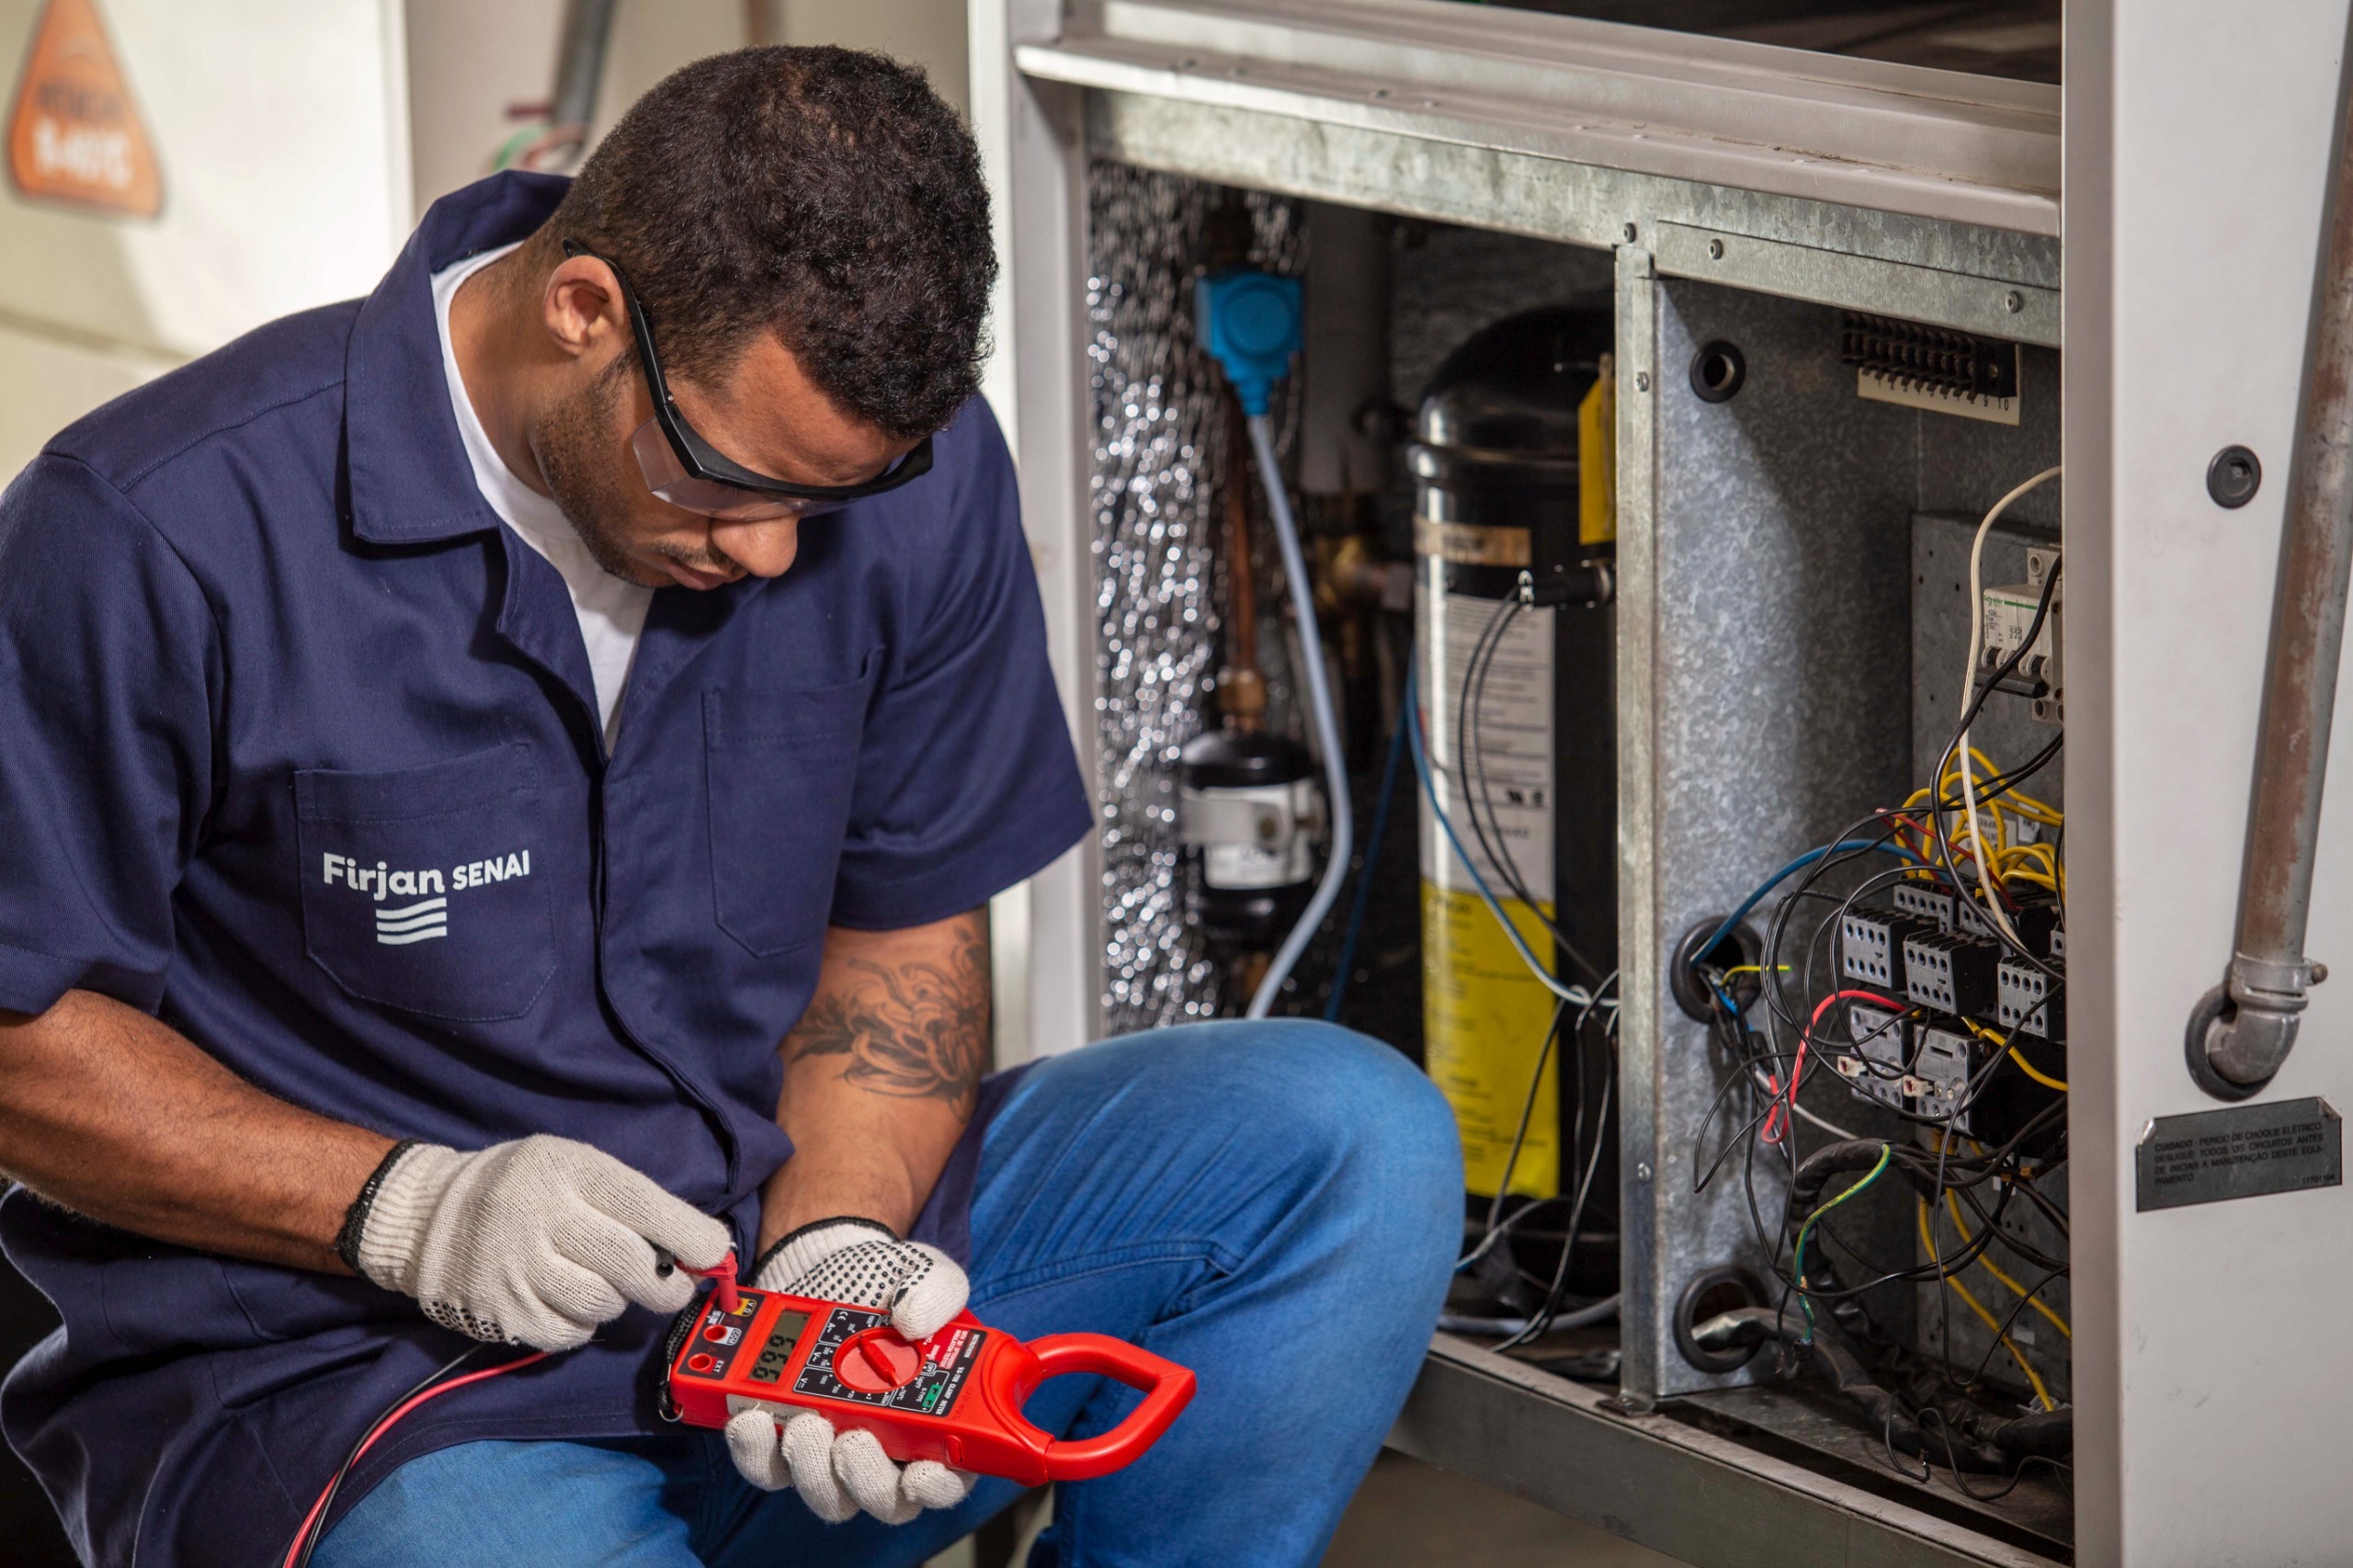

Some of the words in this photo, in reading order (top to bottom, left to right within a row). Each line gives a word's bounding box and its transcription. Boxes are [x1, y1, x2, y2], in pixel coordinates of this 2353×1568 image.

[1998, 397, 2009, 411] 10
[324, 852, 445, 902] Firjan
[452, 849, 530, 891] SENAI
[2154, 1140, 2193, 1153] CUIDADO
[2199, 1135, 2230, 1146] PERIGO
[2232, 1132, 2243, 1142] DE
[2245, 1127, 2280, 1140] CHOQUE
[2154, 1150, 2195, 1164] DESLIGUE
[2200, 1146, 2228, 1157] TODOS
[2233, 1143, 2245, 1153] OS
[2249, 1137, 2292, 1150] CIRCUITOS
[2297, 1132, 2324, 1144] ANTES
[2154, 1165, 2165, 1175] DE
[2169, 1162, 2199, 1173] INICIAR
[2202, 1160, 2208, 1168] A
[2211, 1151, 2268, 1166] MANUTENÇÃO
[2271, 1148, 2298, 1160] DESTE
[2154, 1173, 2194, 1185] PAMENTO
[727, 1328, 740, 1345] COM
[713, 1360, 724, 1373] EXT
[753, 1335, 797, 1381] 66.6
[944, 1383, 956, 1399] CLAMP
[936, 1400, 948, 1415] METER
